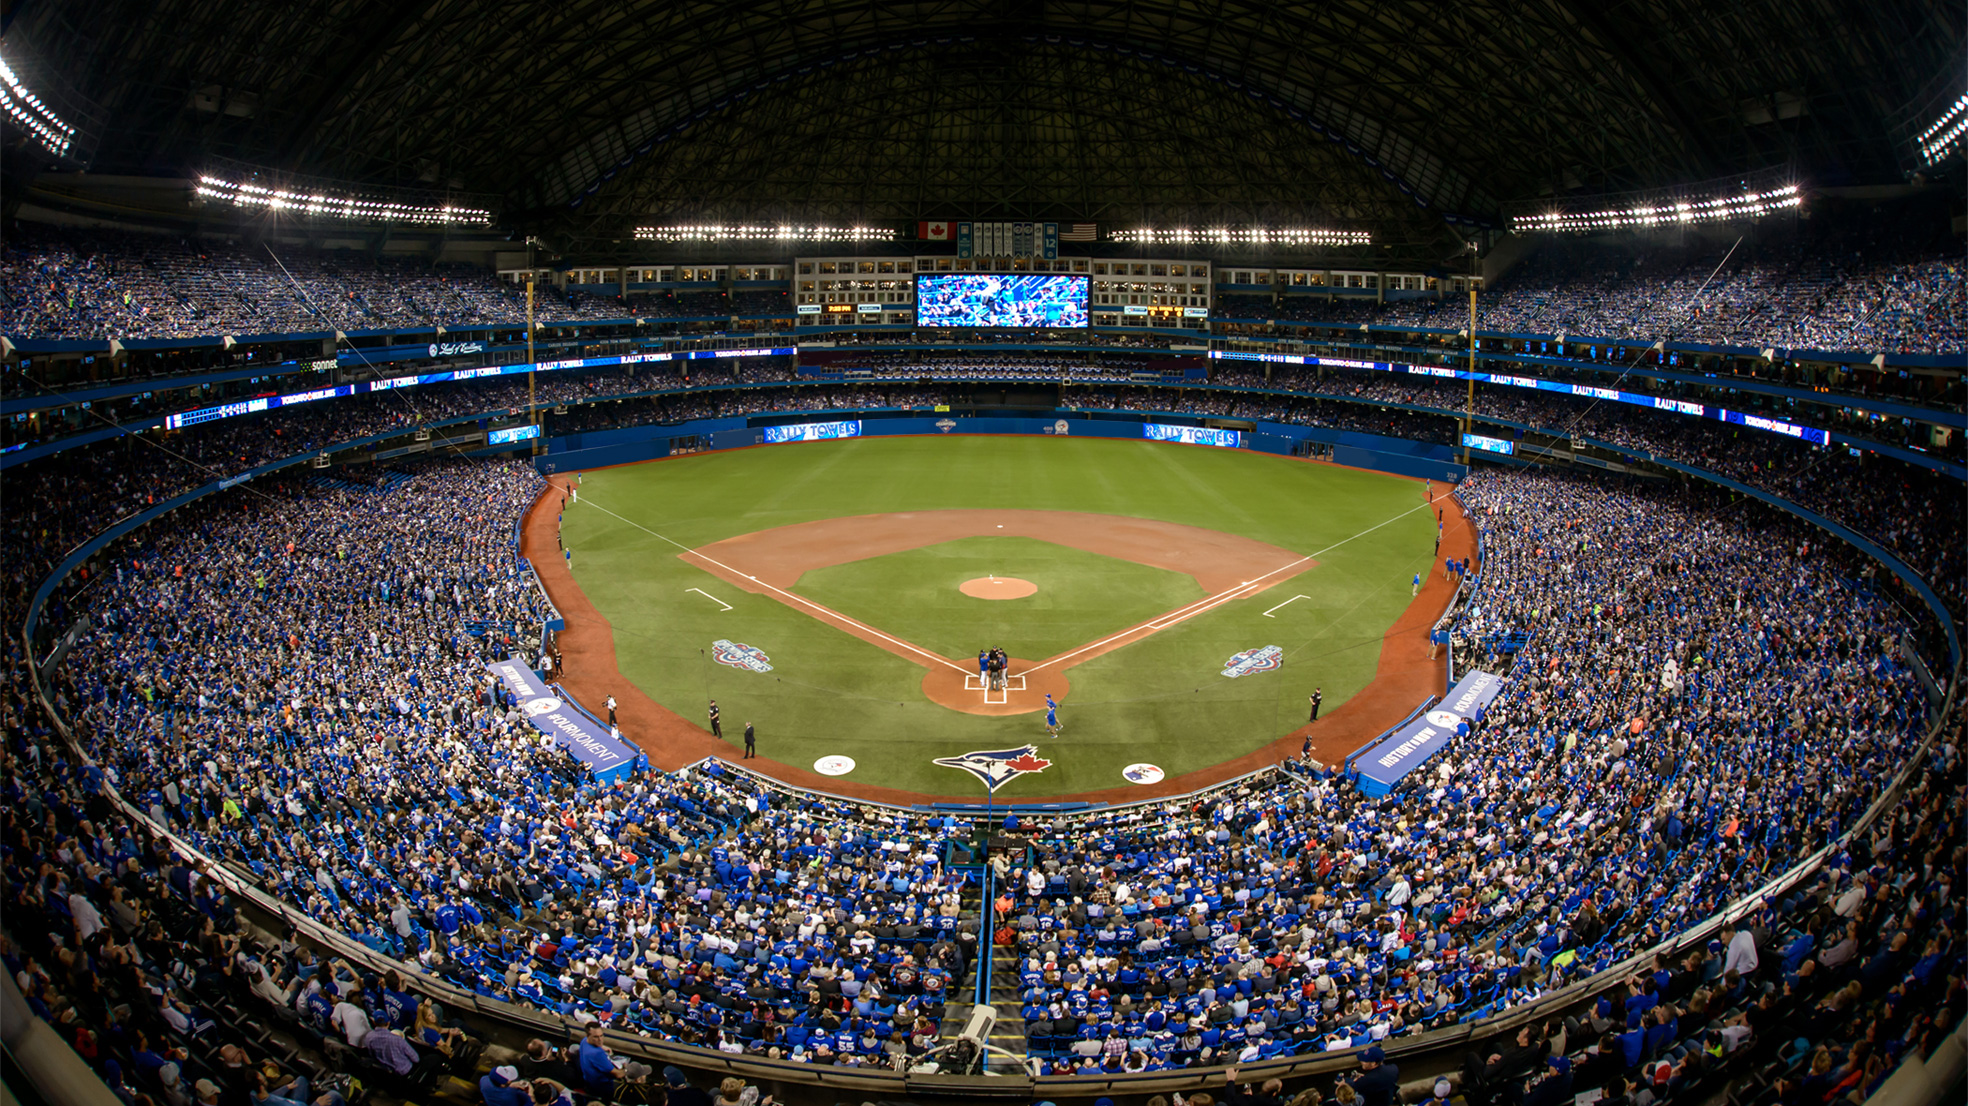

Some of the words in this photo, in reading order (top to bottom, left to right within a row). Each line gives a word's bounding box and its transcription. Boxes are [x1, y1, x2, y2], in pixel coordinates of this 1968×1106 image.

[312, 359, 338, 371] sonnet
[537, 362, 559, 371] RALLY
[559, 359, 583, 369] TOWELS
[621, 355, 642, 364] RALLY
[643, 353, 672, 362] TOWELS
[454, 369, 476, 380] RALLY
[476, 366, 501, 377] TOWELS
[1408, 365, 1430, 375] RALLY
[1430, 367, 1455, 378] TOWELS
[370, 379, 392, 391] RALLY
[392, 376, 418, 388] TOWELS
[1490, 374, 1512, 385] RALLY
[1512, 377, 1537, 388] TOWELS
[1572, 384, 1594, 396] RALLY
[1594, 387, 1619, 400] TOWELS
[1654, 397, 1676, 411] RALLY
[1677, 401, 1704, 416] TOWELS
[767, 426, 806, 441] RALLY
[810, 423, 856, 437] TOWELS
[1145, 425, 1183, 438] RALLY
[1187, 429, 1235, 445] TOWELS
[1452, 672, 1493, 713] #OURMOMENT
[546, 713, 620, 761] #OURMOMENT
[1378, 740, 1417, 769] HISTORY
[838, 1041, 855, 1051] 55
